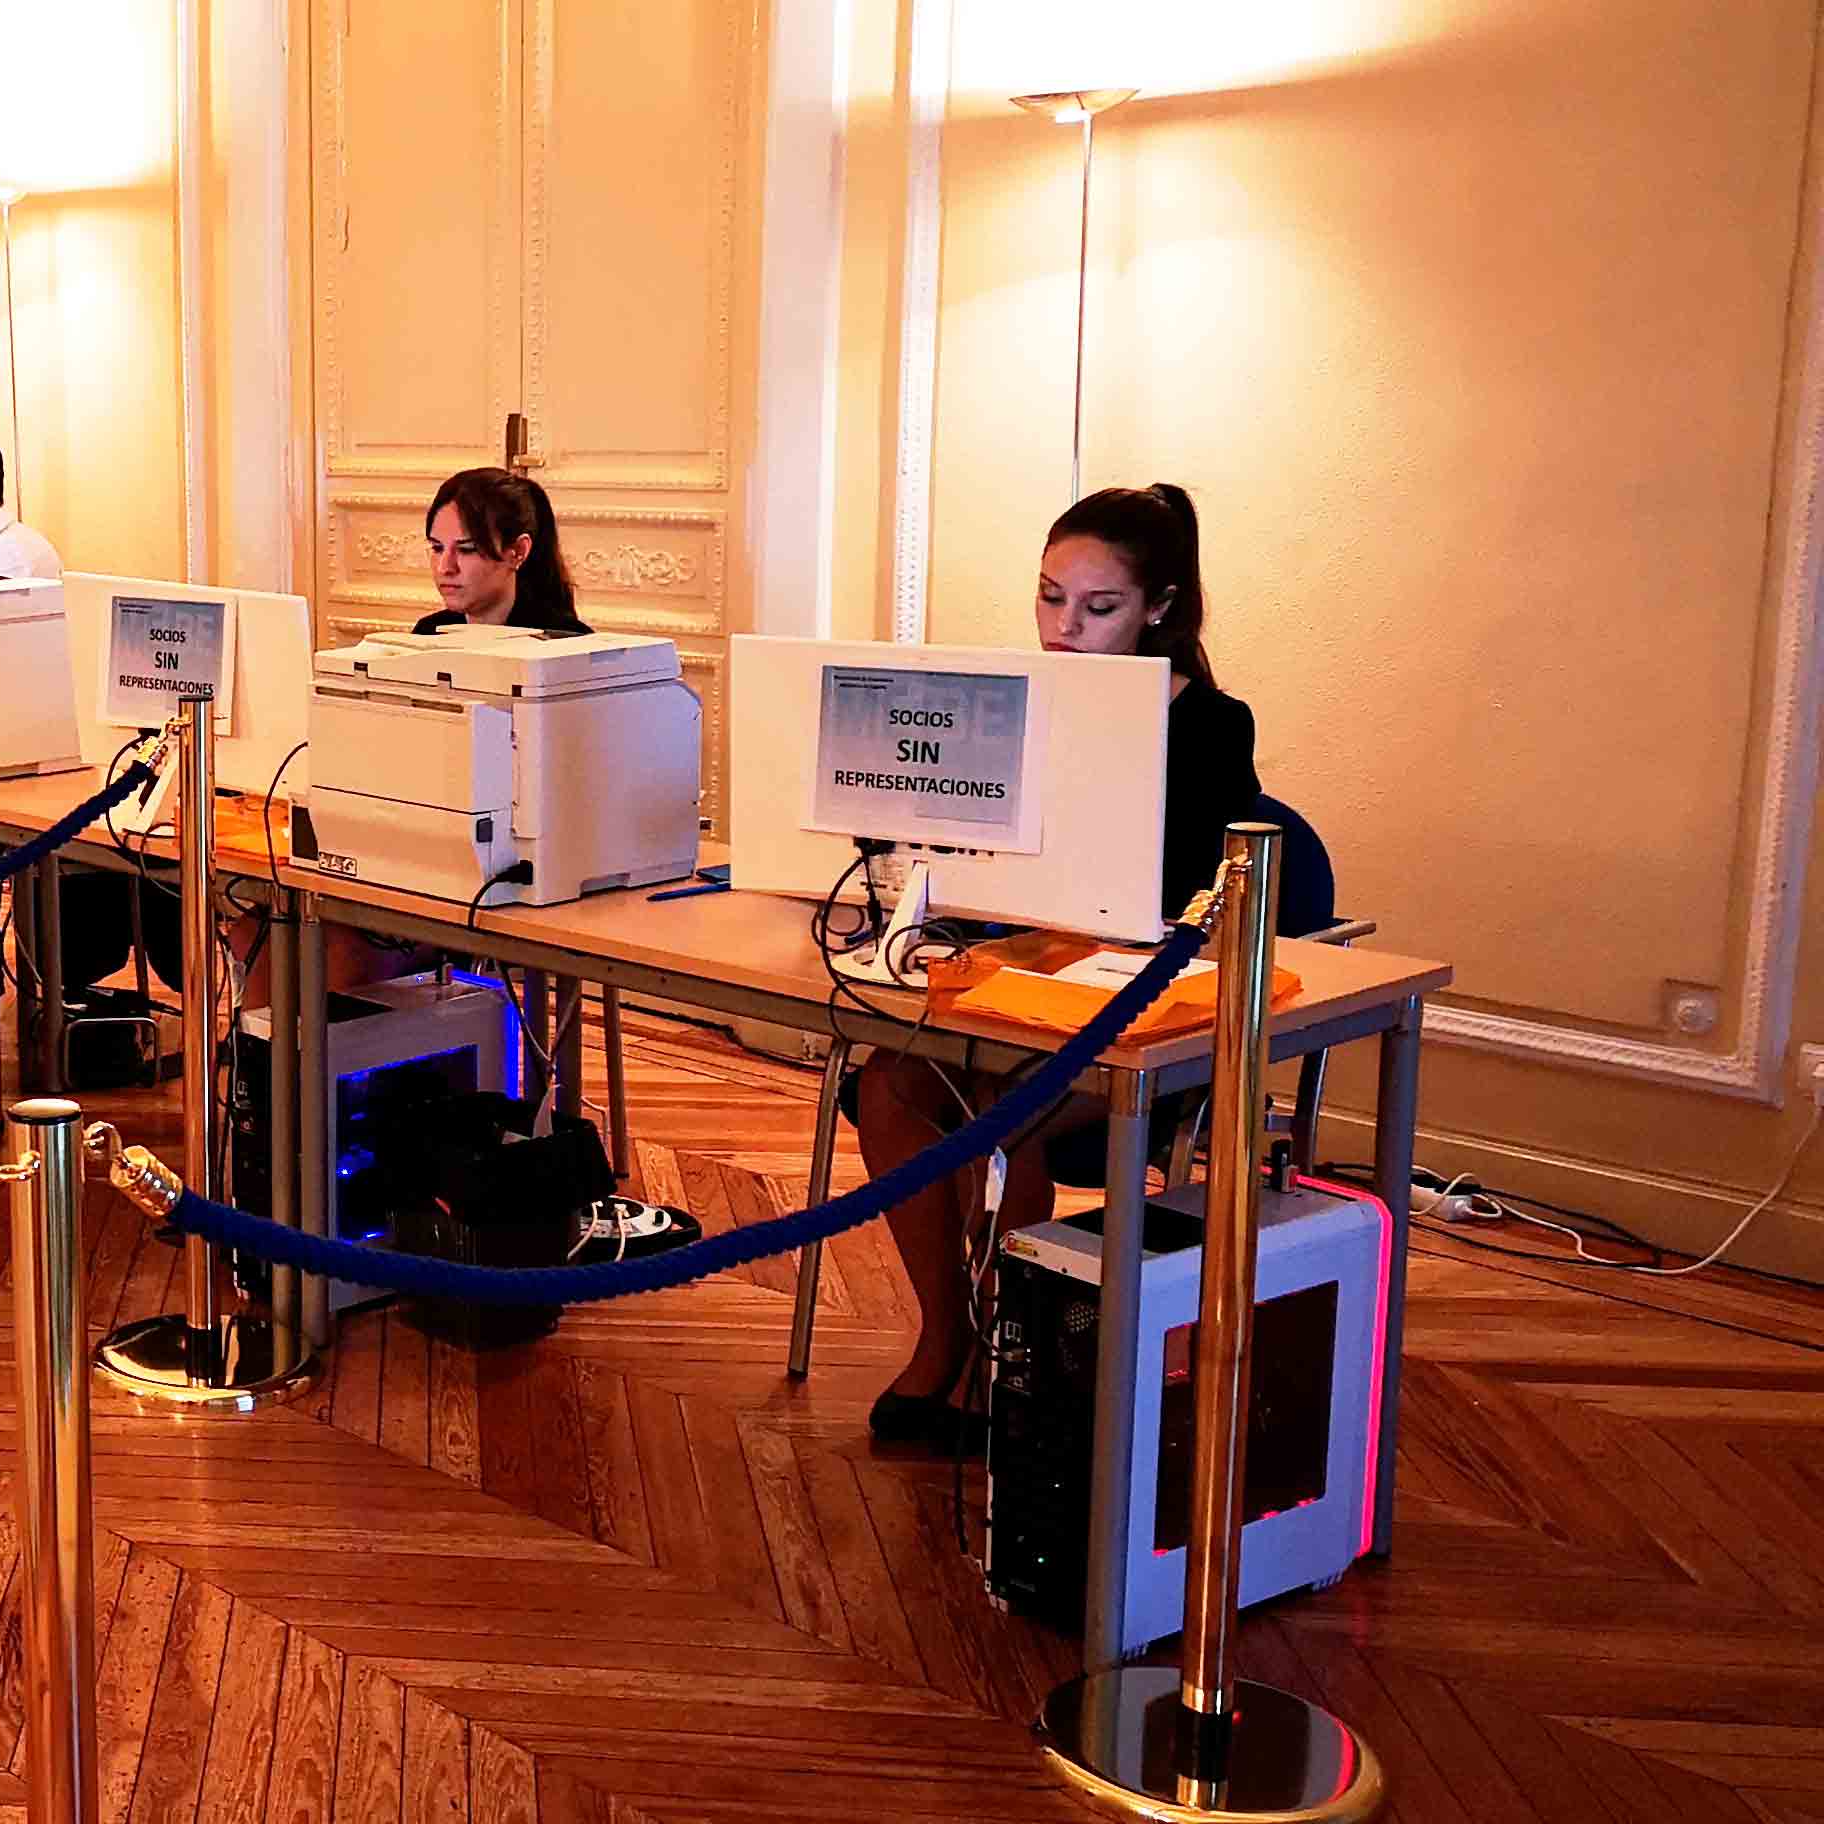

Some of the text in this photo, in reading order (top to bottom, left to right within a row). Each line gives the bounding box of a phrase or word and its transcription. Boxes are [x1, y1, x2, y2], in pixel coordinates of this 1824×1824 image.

[149, 628, 186, 643] SOCIOS
[154, 651, 179, 670] SIN
[119, 675, 215, 696] REPRESENTACIONES
[889, 708, 954, 728] SOCIOS
[896, 739, 940, 764] SIN
[834, 769, 1006, 799] REPRESENTACIONES
